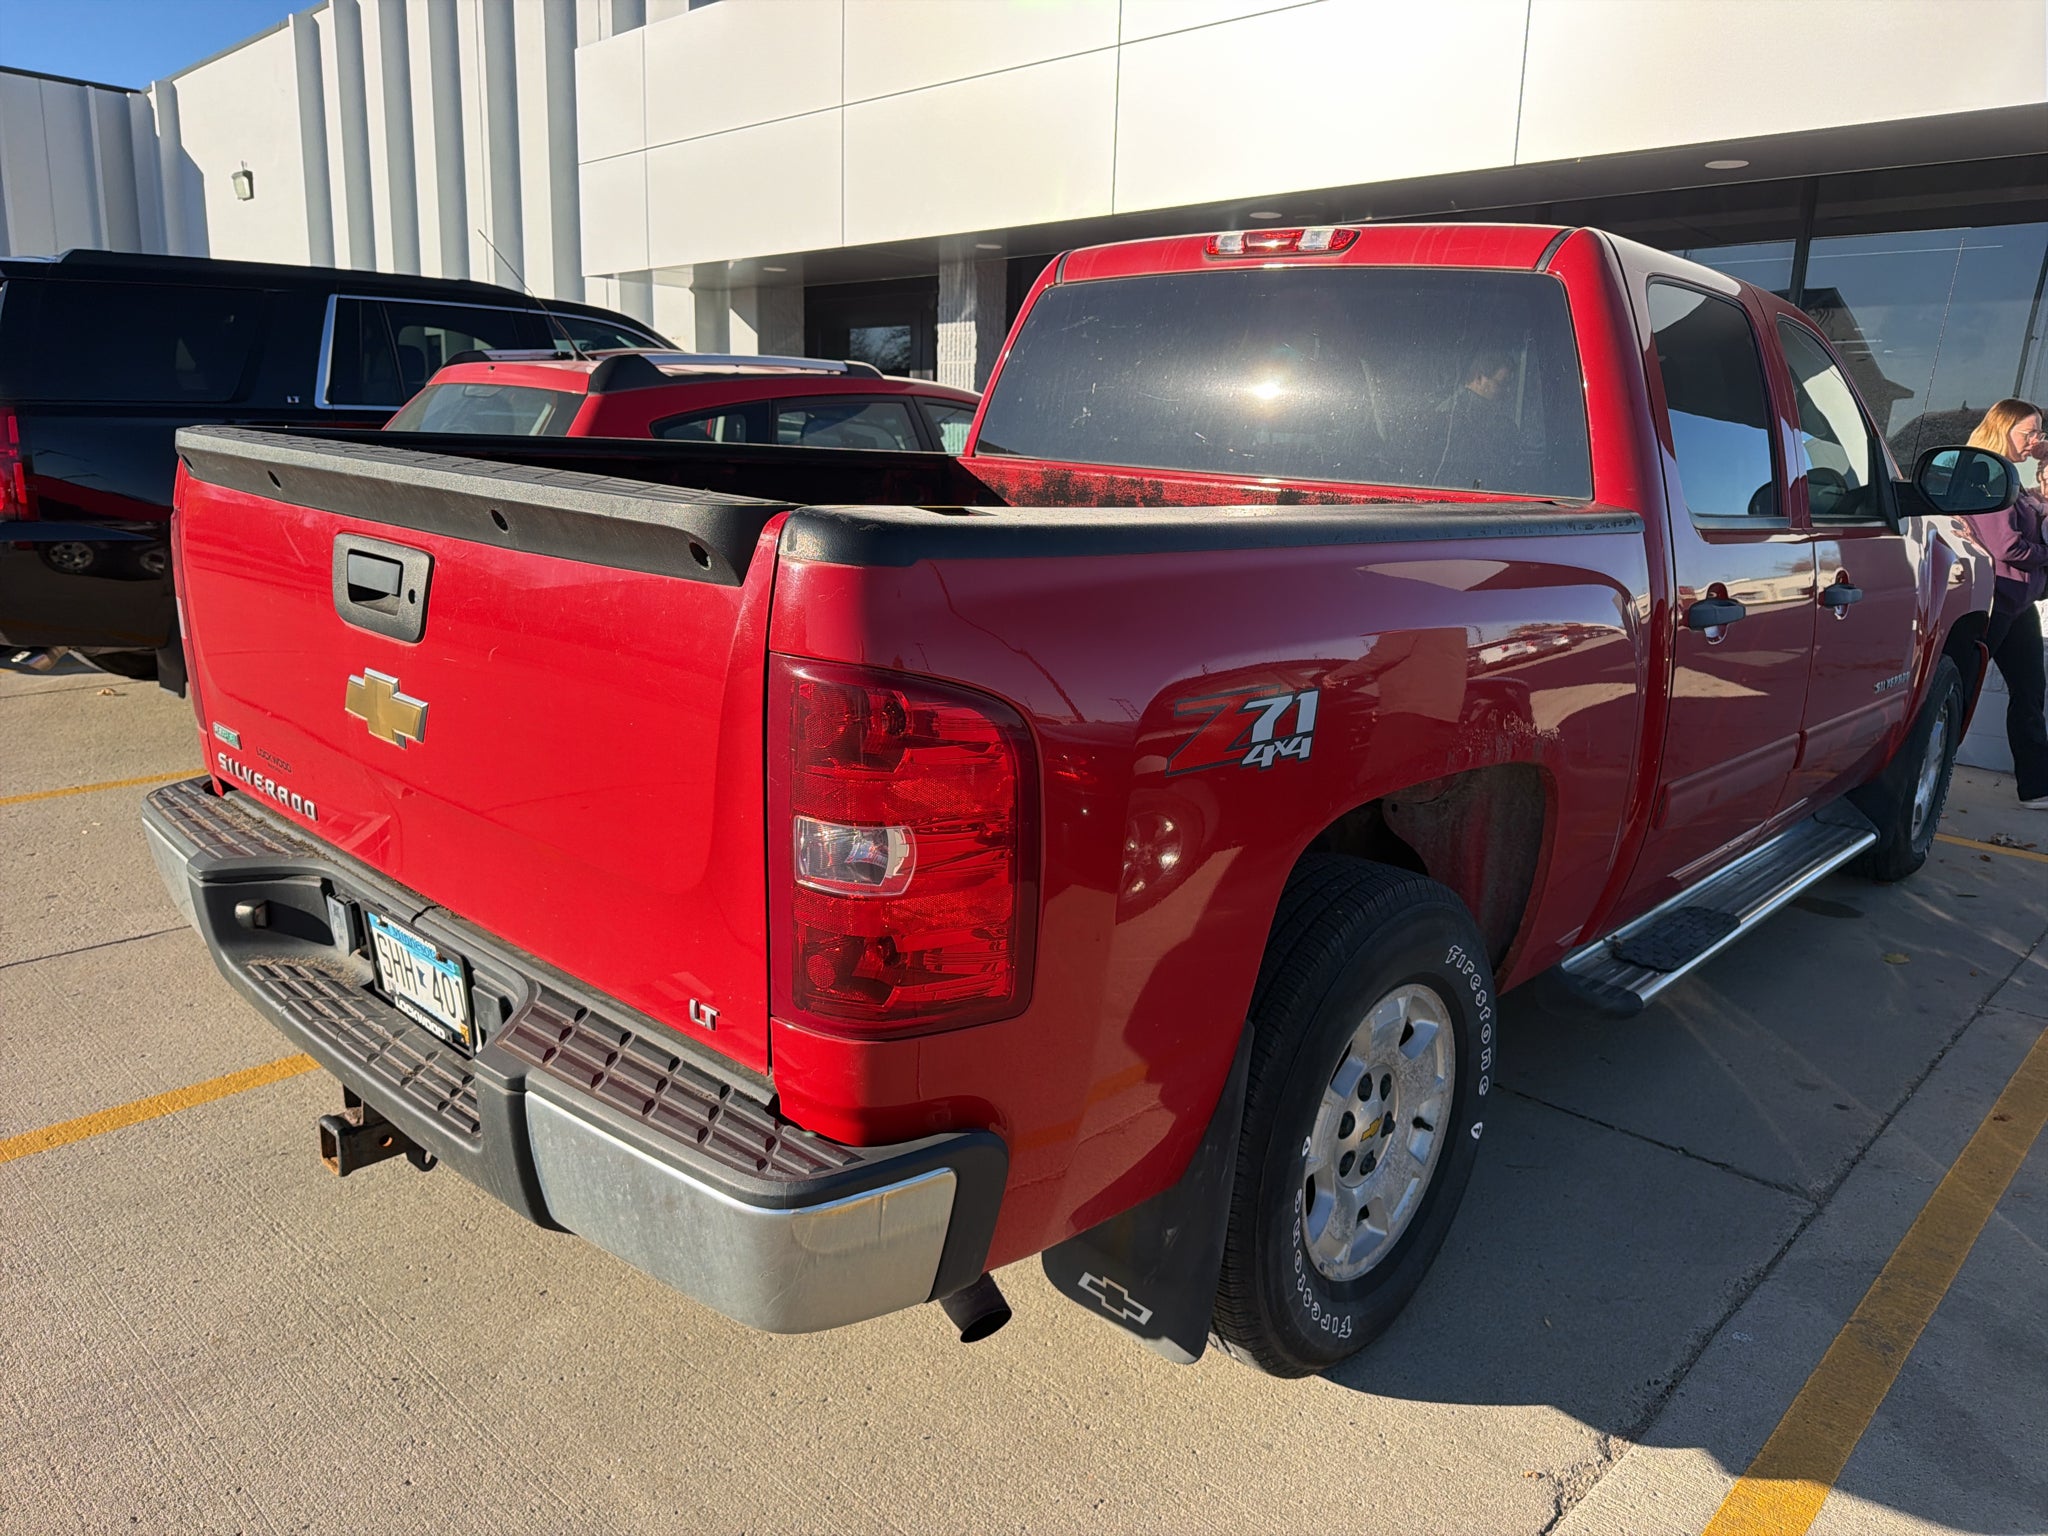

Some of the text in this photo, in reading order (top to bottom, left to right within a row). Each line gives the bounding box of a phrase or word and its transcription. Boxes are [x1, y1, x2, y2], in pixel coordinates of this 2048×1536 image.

[287, 395, 300, 403] LT
[1165, 682, 1320, 777] Z71
[218, 752, 318, 822] SILVERADO
[377, 932, 419, 995] SHH
[394, 996, 446, 1040] LOCKWOOD
[689, 998, 720, 1031] LT
[1445, 944, 1491, 1096] Firestone
[1293, 1188, 1352, 1338] Firestone
